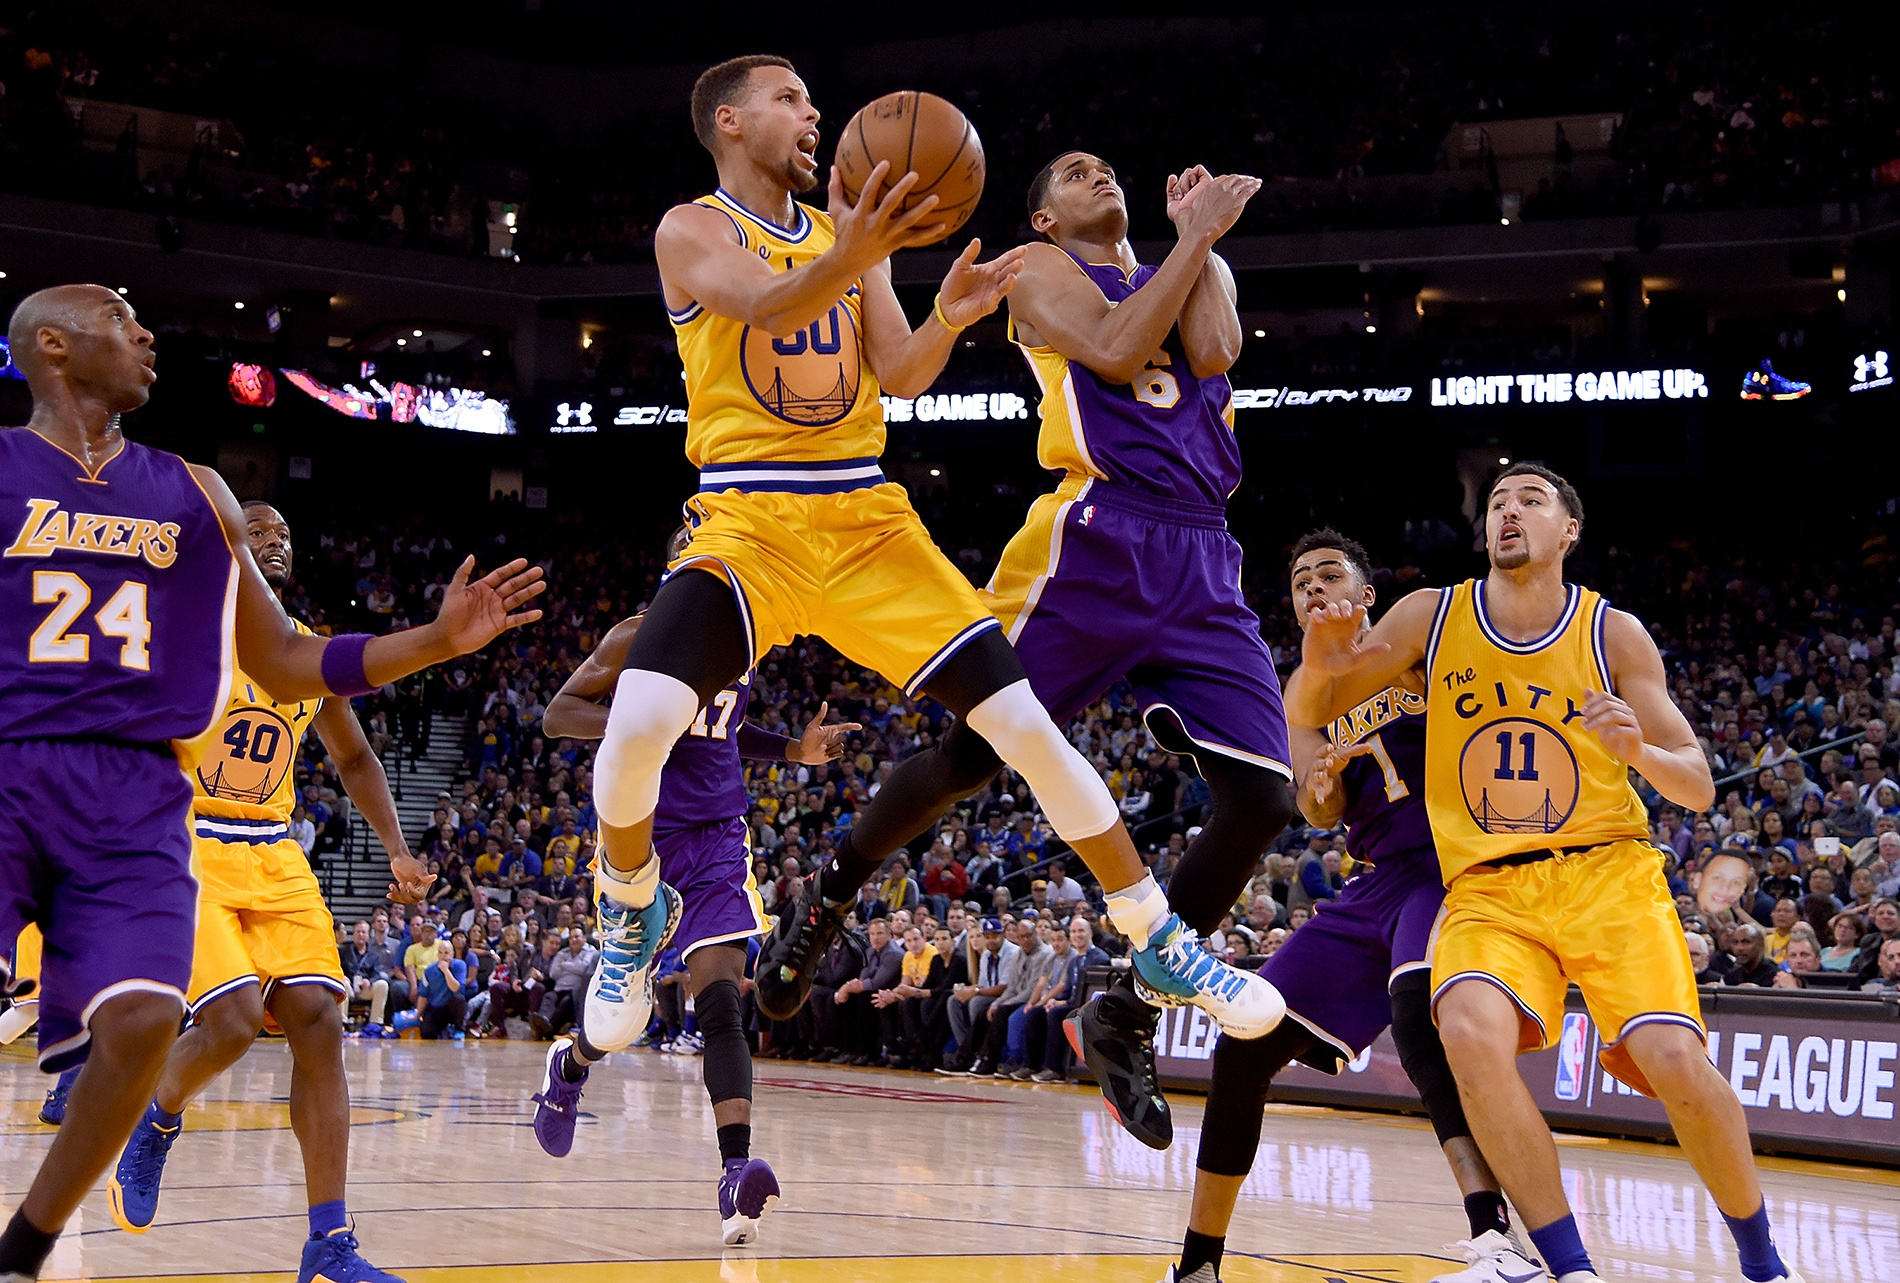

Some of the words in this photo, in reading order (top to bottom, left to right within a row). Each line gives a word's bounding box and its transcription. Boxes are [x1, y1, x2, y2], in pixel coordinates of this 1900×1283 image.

[1131, 347, 1182, 409] 6
[1431, 375, 1514, 406] LIGHT
[1516, 373, 1573, 403] THE
[1574, 370, 1661, 401] GAME
[1662, 369, 1709, 398] UP.
[879, 396, 915, 422] HE
[915, 394, 988, 422] GAME
[989, 393, 1028, 420] UP.
[3, 498, 181, 569] LAKERS
[29, 570, 152, 671] 24
[1443, 667, 1477, 690] The
[690, 689, 738, 740] 17
[1455, 682, 1585, 726] CITY
[224, 719, 281, 764] 40
[1494, 731, 1539, 781] 11
[1366, 733, 1410, 803] 1
